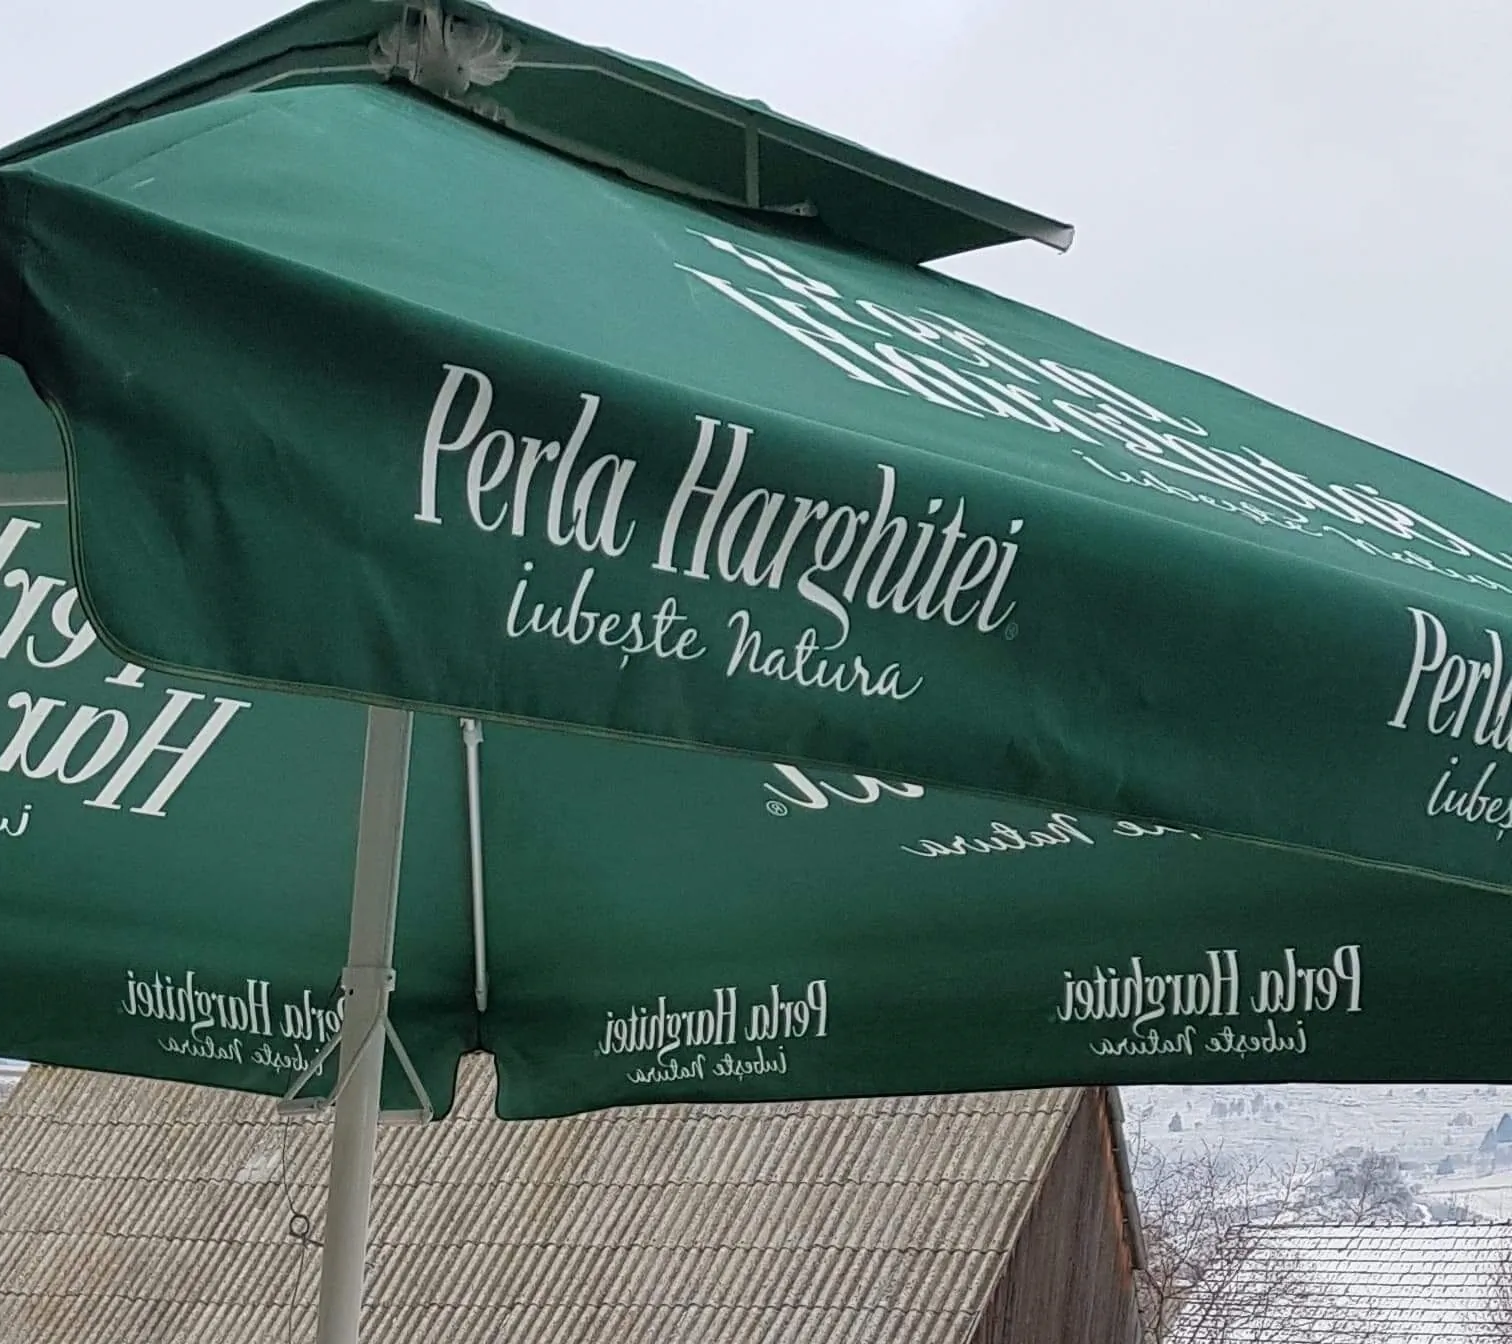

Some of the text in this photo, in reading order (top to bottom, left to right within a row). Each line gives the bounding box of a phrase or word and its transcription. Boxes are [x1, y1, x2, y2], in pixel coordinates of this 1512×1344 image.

[413, 363, 1018, 651] Perla Harghitei
[725, 609, 925, 700] Natura
[1427, 757, 1512, 841] iube
